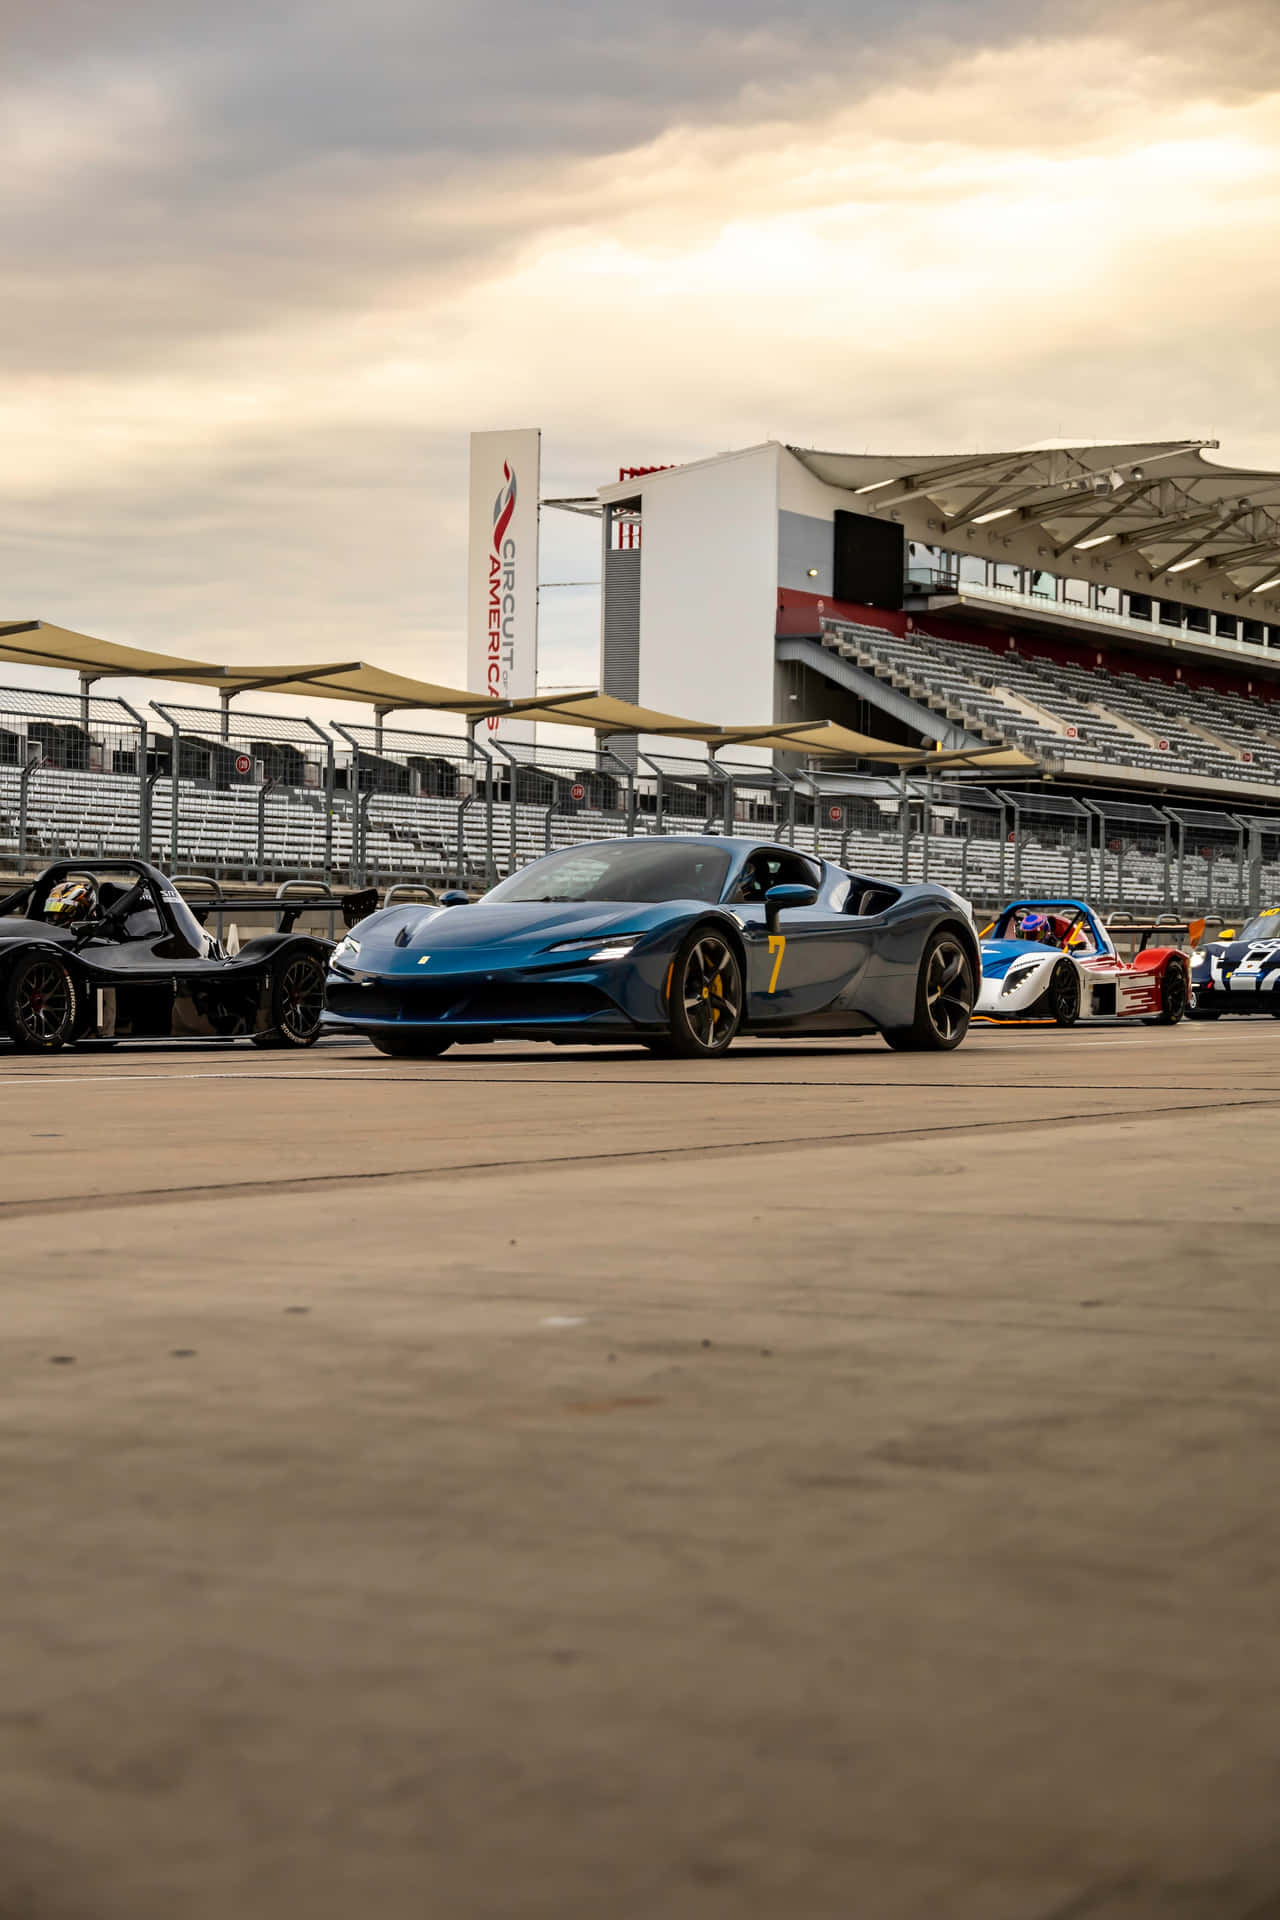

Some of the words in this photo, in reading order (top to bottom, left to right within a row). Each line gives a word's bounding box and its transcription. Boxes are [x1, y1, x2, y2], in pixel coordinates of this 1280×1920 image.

[487, 553, 501, 731] AMERICAS
[502, 538, 515, 671] CIRCUIT
[768, 935, 786, 994] 7
